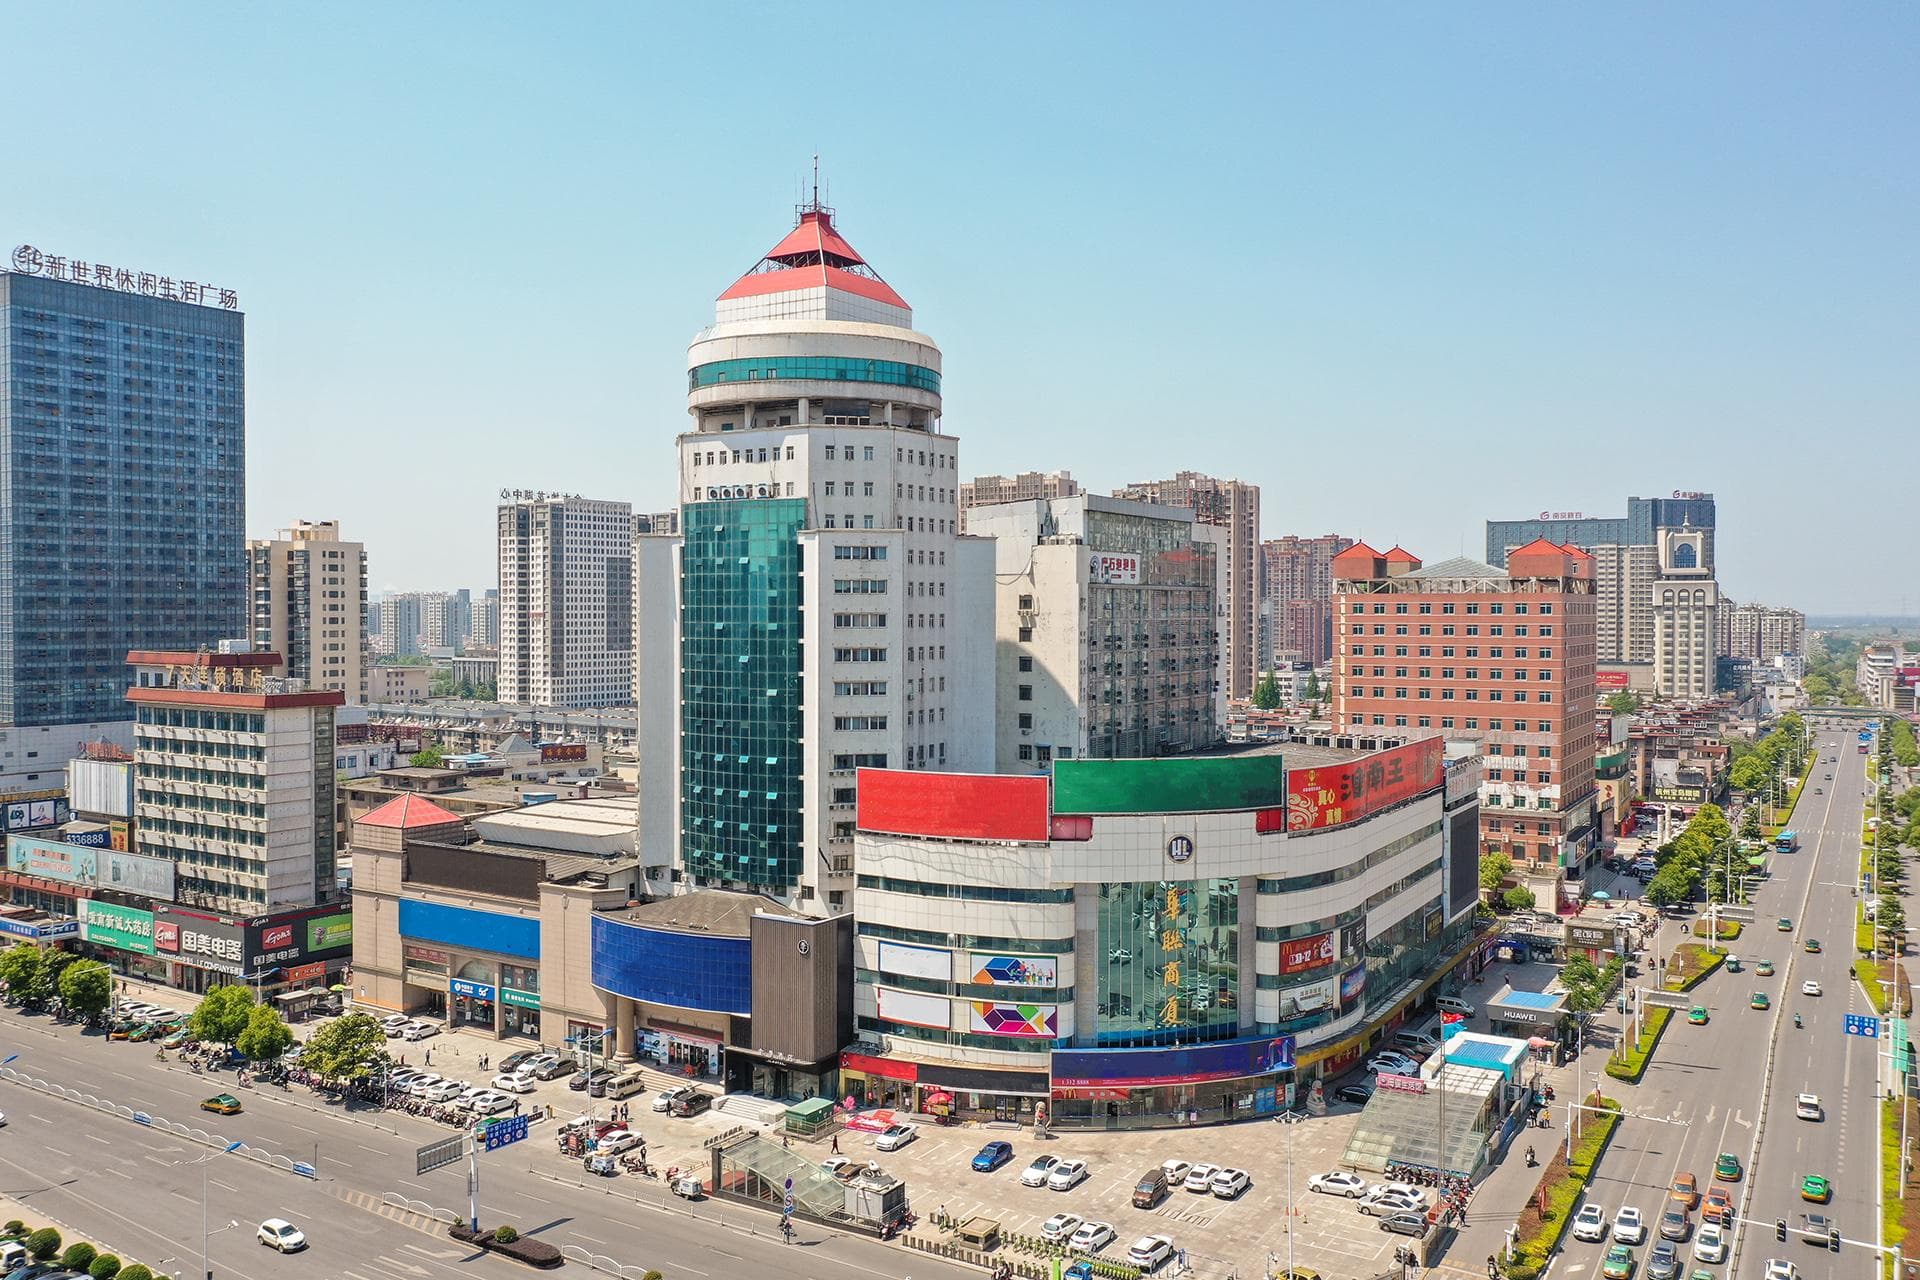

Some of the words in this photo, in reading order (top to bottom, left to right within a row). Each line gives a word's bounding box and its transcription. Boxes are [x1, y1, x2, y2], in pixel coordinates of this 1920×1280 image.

[45, 253, 238, 309] 新世界休闲生活广场
[165, 664, 262, 688] 7天连锁酒店
[182, 930, 242, 962] 国美电器
[253, 947, 299, 966] 国美电器
[1504, 1010, 1537, 1022] HUAWEI
